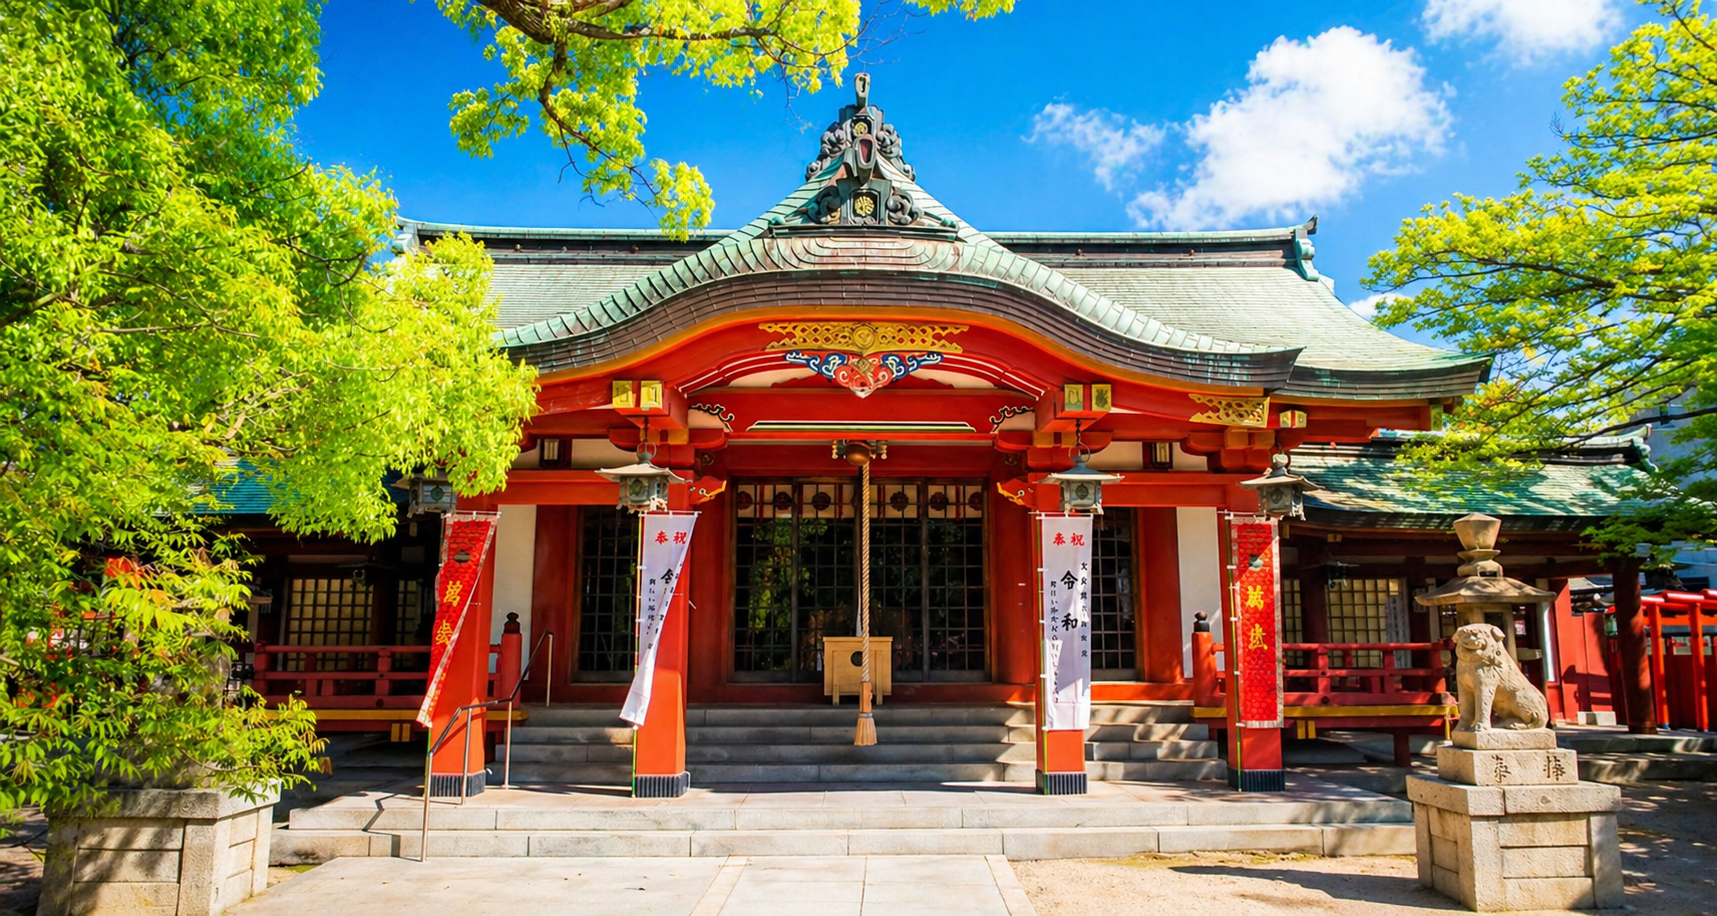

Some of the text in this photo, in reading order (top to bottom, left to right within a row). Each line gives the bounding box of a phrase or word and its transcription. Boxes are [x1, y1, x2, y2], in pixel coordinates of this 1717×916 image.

[655, 530, 687, 545] 奉祝
[1053, 531, 1085, 546] 奉祝
[1060, 570, 1079, 631] 令和
